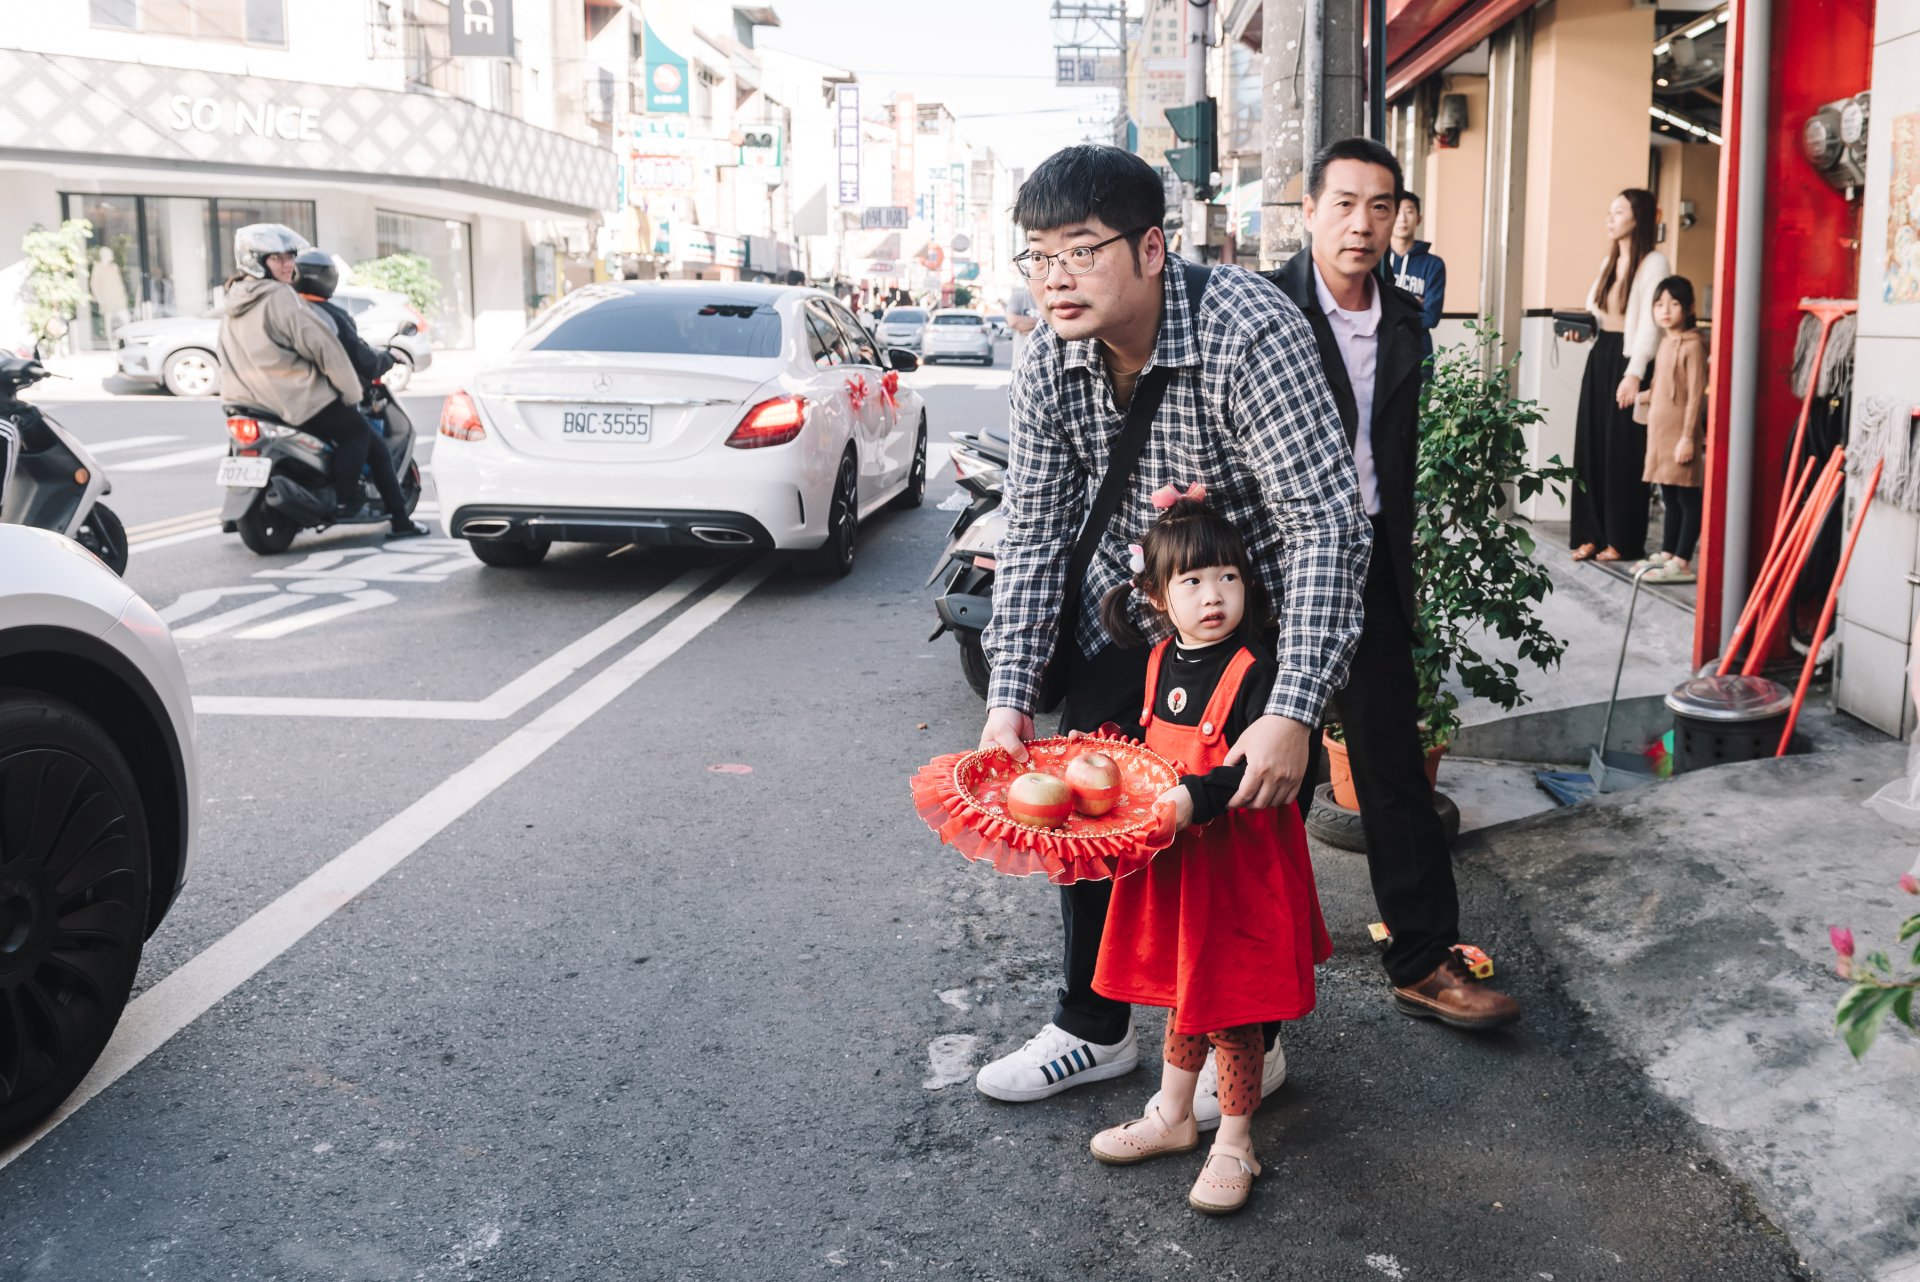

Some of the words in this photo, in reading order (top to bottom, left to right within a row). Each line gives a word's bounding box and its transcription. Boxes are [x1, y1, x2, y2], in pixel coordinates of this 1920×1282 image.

[170, 95, 221, 132] SO
[234, 101, 321, 141] NICE
[1394, 273, 1425, 295] CAN
